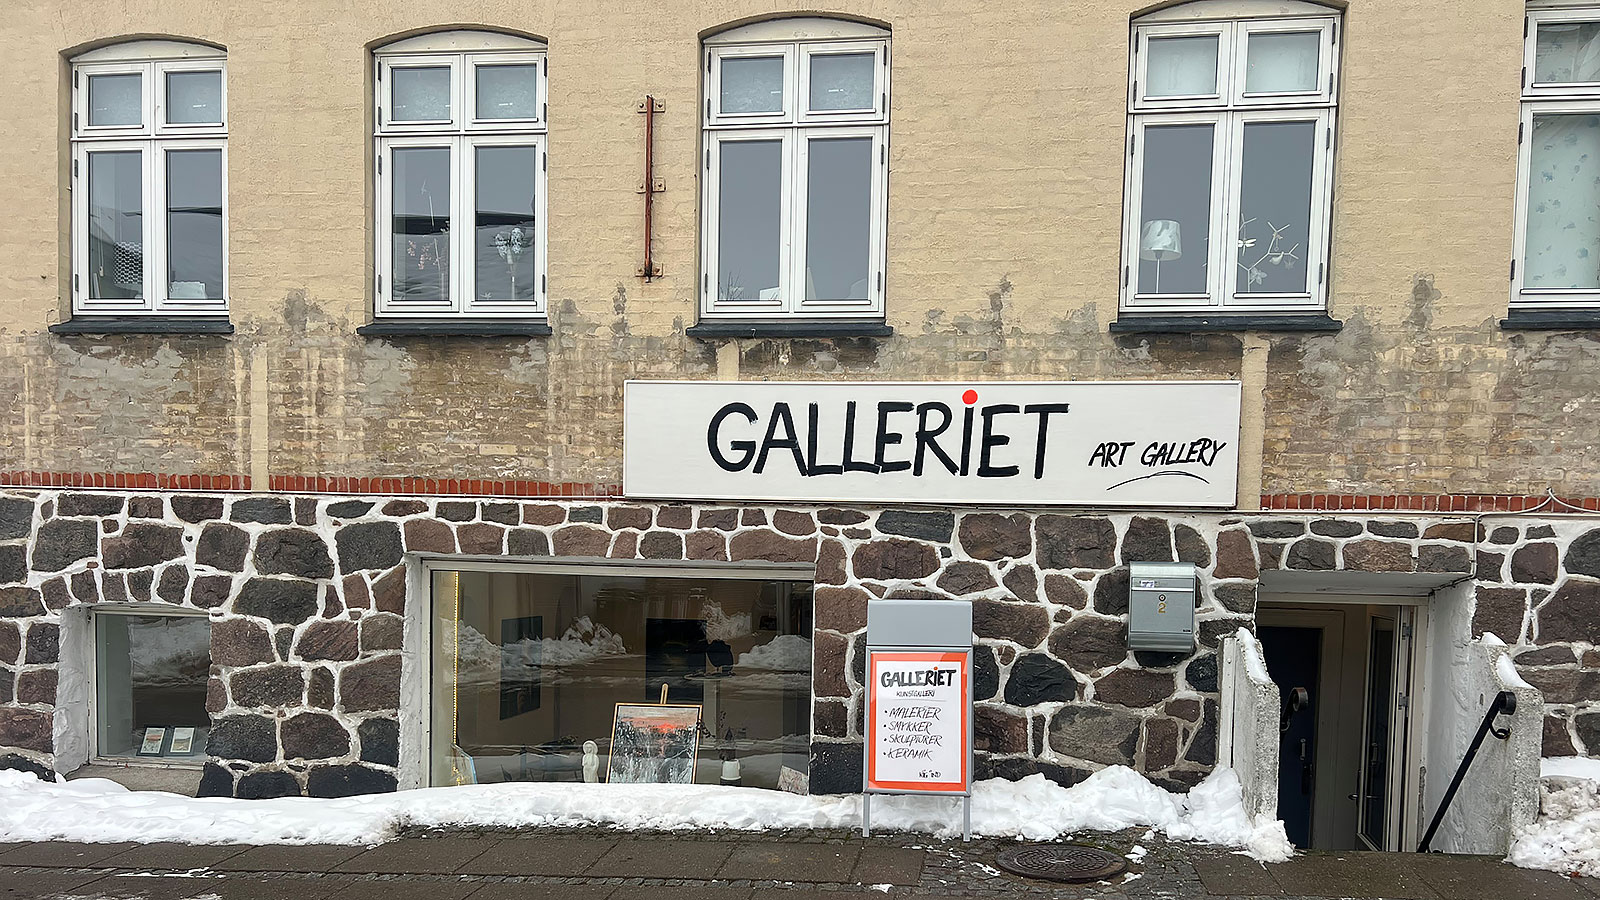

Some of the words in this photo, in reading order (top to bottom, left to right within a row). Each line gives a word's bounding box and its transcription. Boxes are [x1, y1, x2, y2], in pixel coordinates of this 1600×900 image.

[1088, 442, 1126, 468] ART
[1140, 438, 1226, 469] GALLERY
[1158, 602, 1167, 614] 2
[888, 721, 933, 734] SMYKKER
[888, 733, 943, 747] SKULPTURER
[887, 748, 934, 761] KERAMIK
